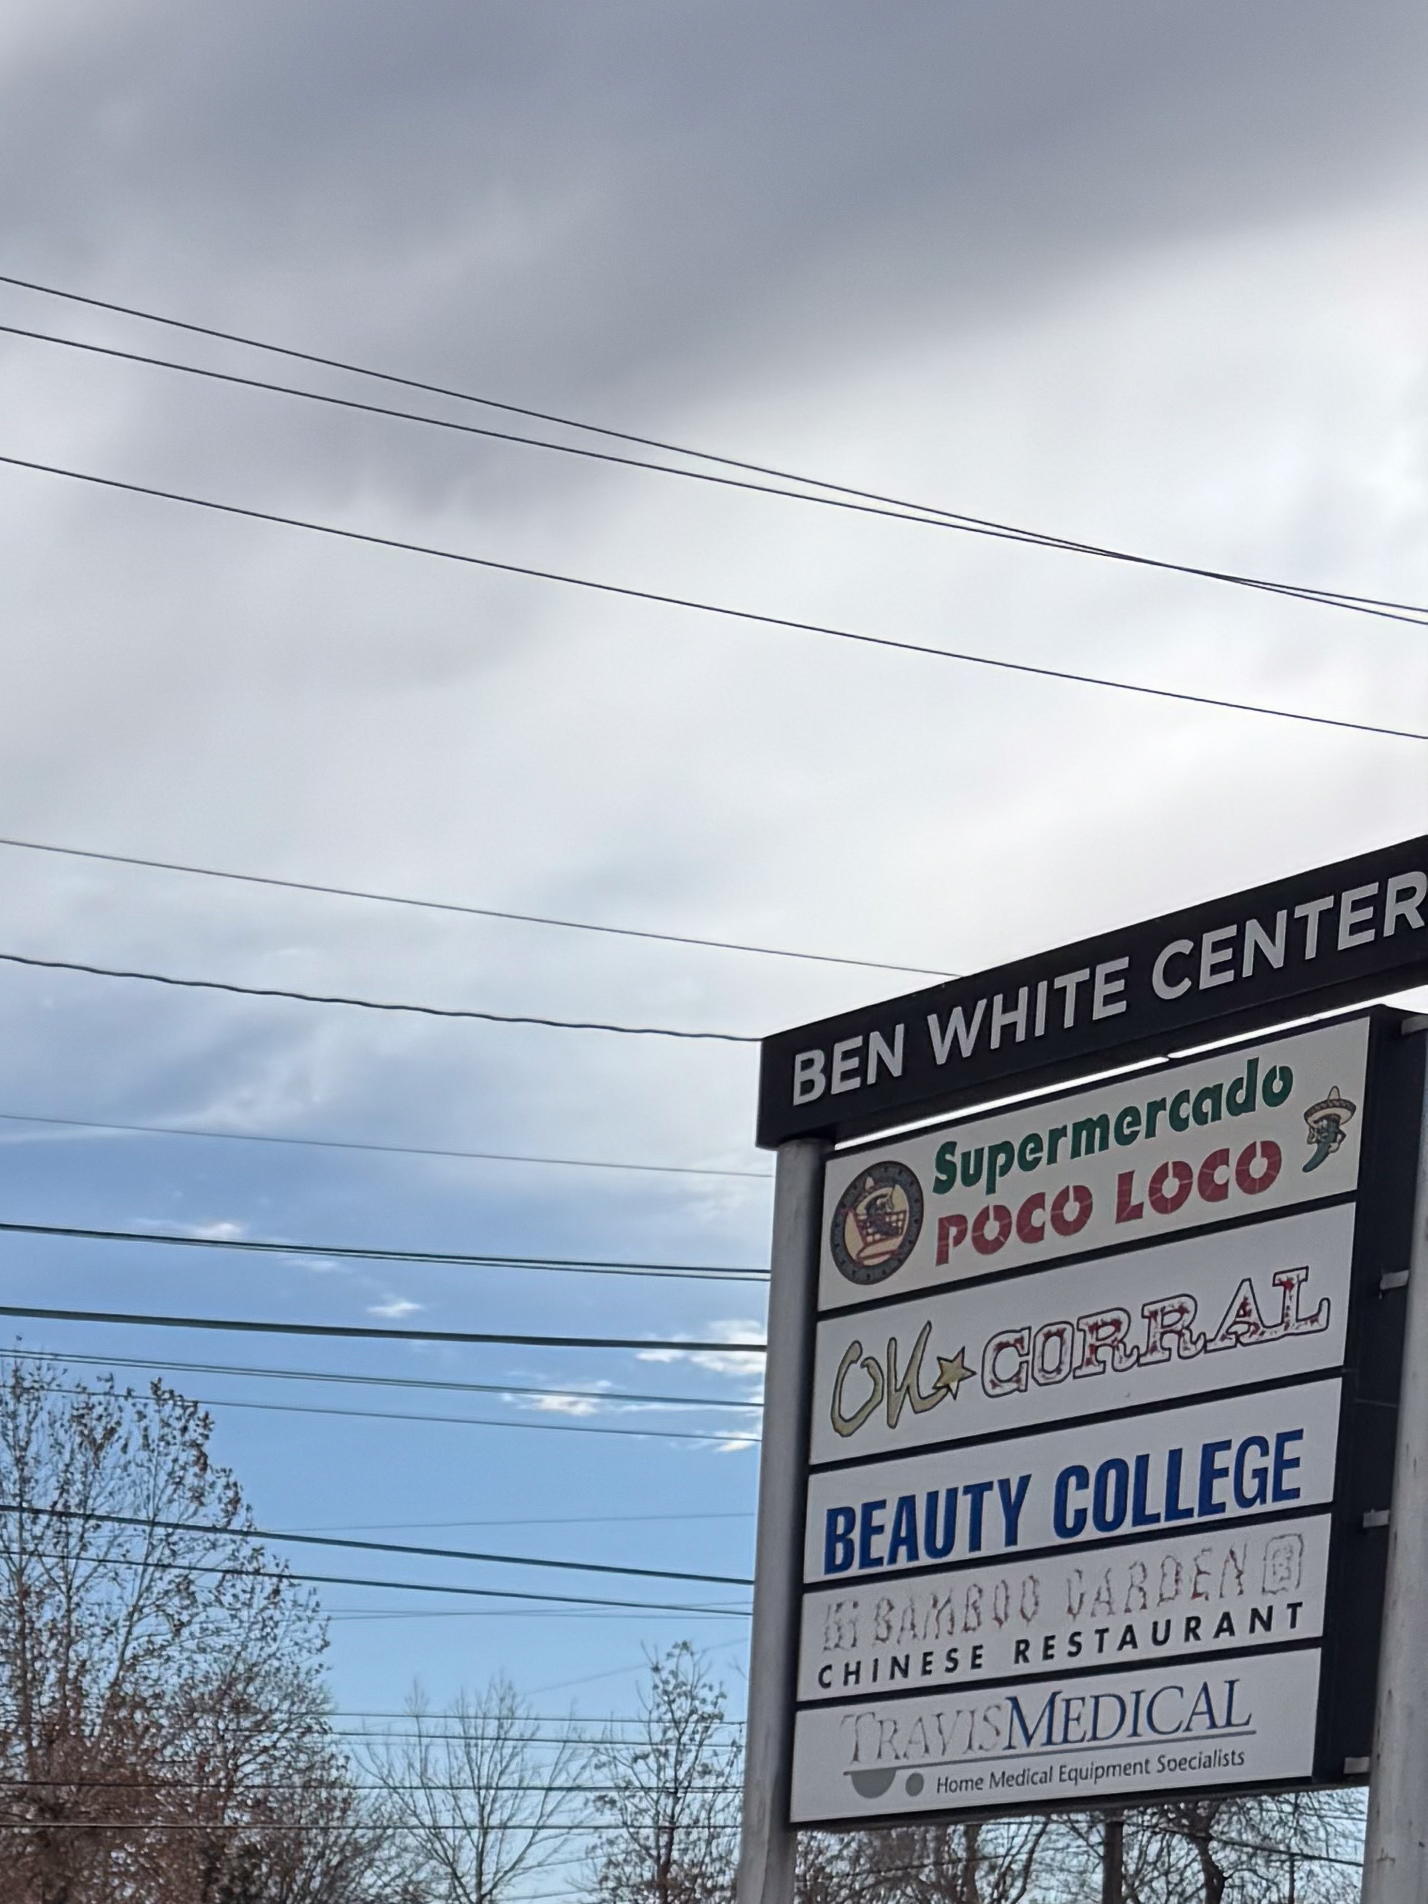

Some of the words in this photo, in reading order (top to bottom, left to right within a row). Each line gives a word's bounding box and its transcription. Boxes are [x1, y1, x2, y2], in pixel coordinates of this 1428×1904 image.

[792, 1022, 906, 1107] BEN
[926, 956, 1130, 1066] WHITE
[1151, 870, 1428, 1001] CENTER
[931, 1056, 1295, 1196] Supermercado
[934, 1184, 1094, 1267] POCO
[1114, 1139, 1283, 1225] LOCO
[980, 1265, 1331, 1399] CORRAL
[823, 1473, 1033, 1576] BEAUTY
[1052, 1428, 1305, 1540] COLLEGE
[817, 1644, 984, 1690] CHINESE
[1013, 1601, 1304, 1665] RESTAURANT
[936, 1775, 984, 1794] Home
[988, 1768, 1054, 1790] Medical
[1058, 1758, 1152, 1786] Equipment
